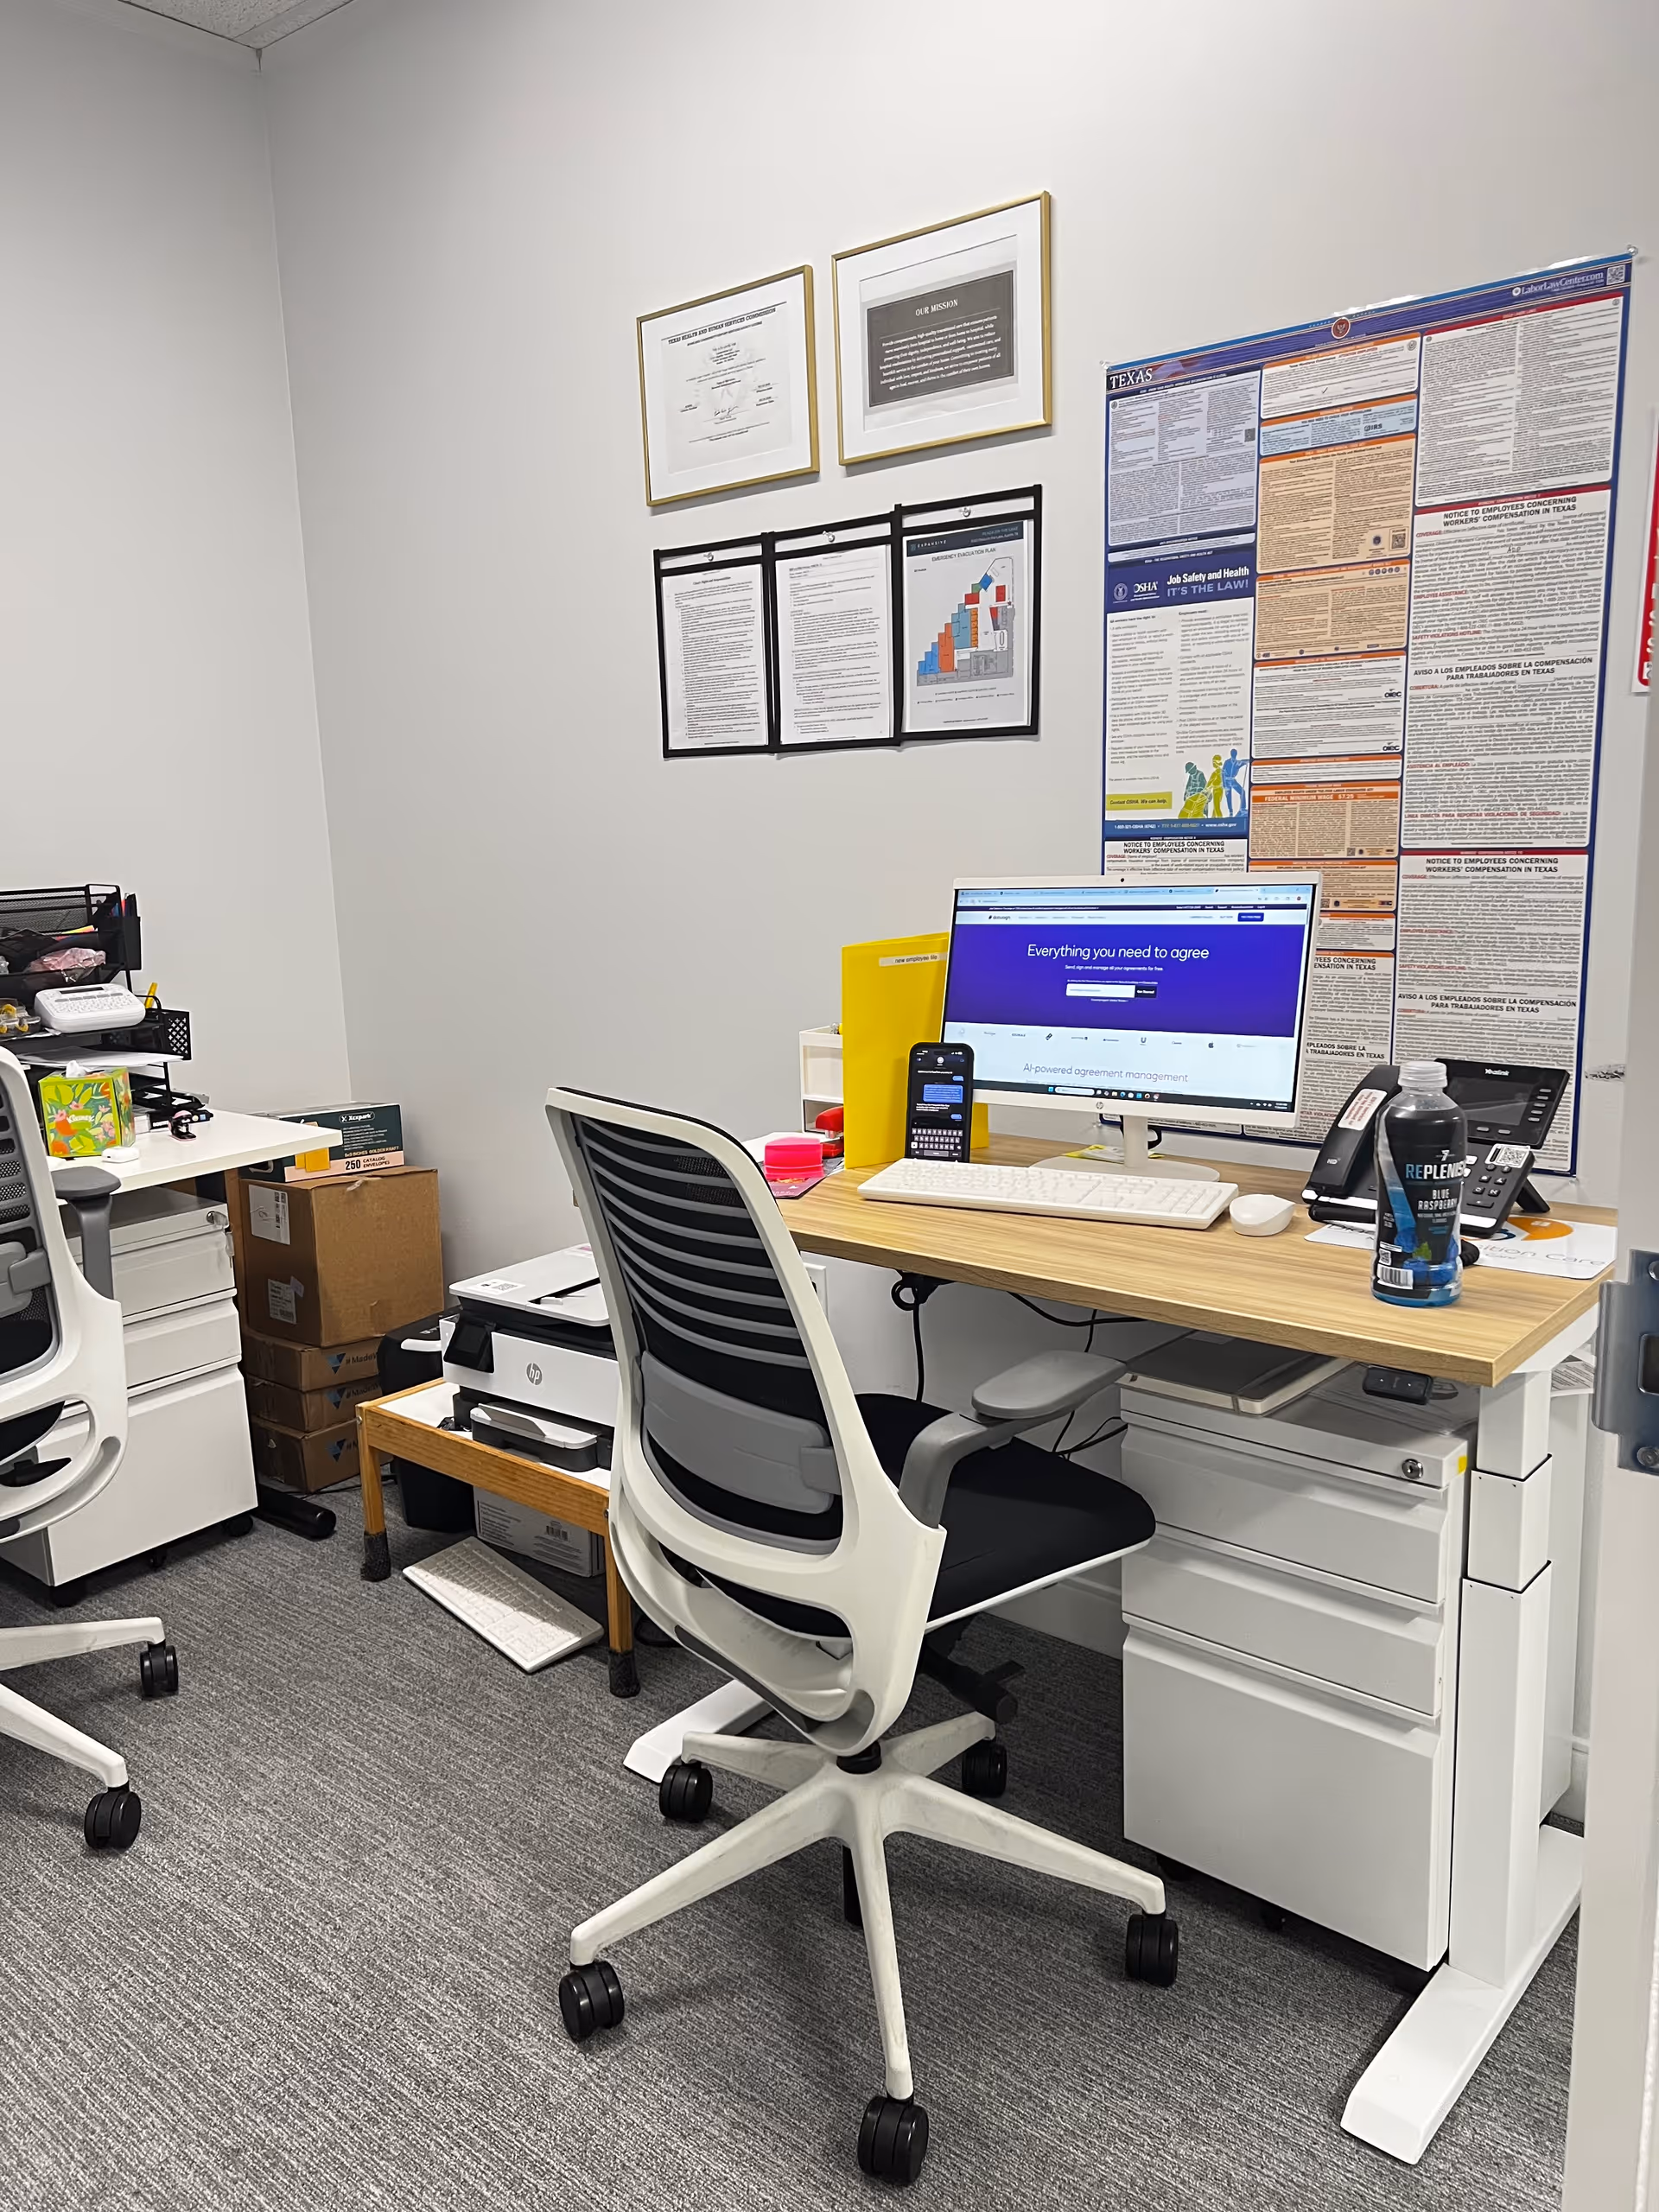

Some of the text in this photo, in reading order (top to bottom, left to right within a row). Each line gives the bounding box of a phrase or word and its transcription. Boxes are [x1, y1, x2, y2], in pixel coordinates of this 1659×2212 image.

[915, 298, 958, 316] OUR MISSION
[1109, 368, 1153, 389] TEXAS
[1443, 509, 1469, 519] NOTICE
[1482, 502, 1525, 514] EMPLOYEES
[1527, 496, 1577, 509] CONCERNING
[1443, 504, 1577, 527] WORKERS' COMPENSATION IN TEXAS
[1166, 566, 1249, 585] Job Safety and Health
[1134, 582, 1158, 594] OSHA
[1167, 579, 1249, 597] IT'S THE LAW!
[1455, 664, 1497, 673] EMPLEADOS
[1535, 657, 1592, 668] COMPENSACIÓN
[1465, 670, 1519, 679] TRABAJADORES
[1027, 944, 1210, 962] Everything you need to agree
[1451, 1003, 1504, 1012] TRABAJADORES
[1519, 998, 1577, 1007] COMPENSACIÓN
[1309, 1048, 1355, 1057] TRABAJADORES
[1023, 1063, 1189, 1082] AI-powered agreement management
[345, 1159, 361, 1171] 250
[1432, 1188, 1450, 1200] BLUE
[1417, 1198, 1458, 1211] RASPBERRY
[1478, 1244, 1605, 1266] ition Care
[527, 1363, 543, 1385] hp
